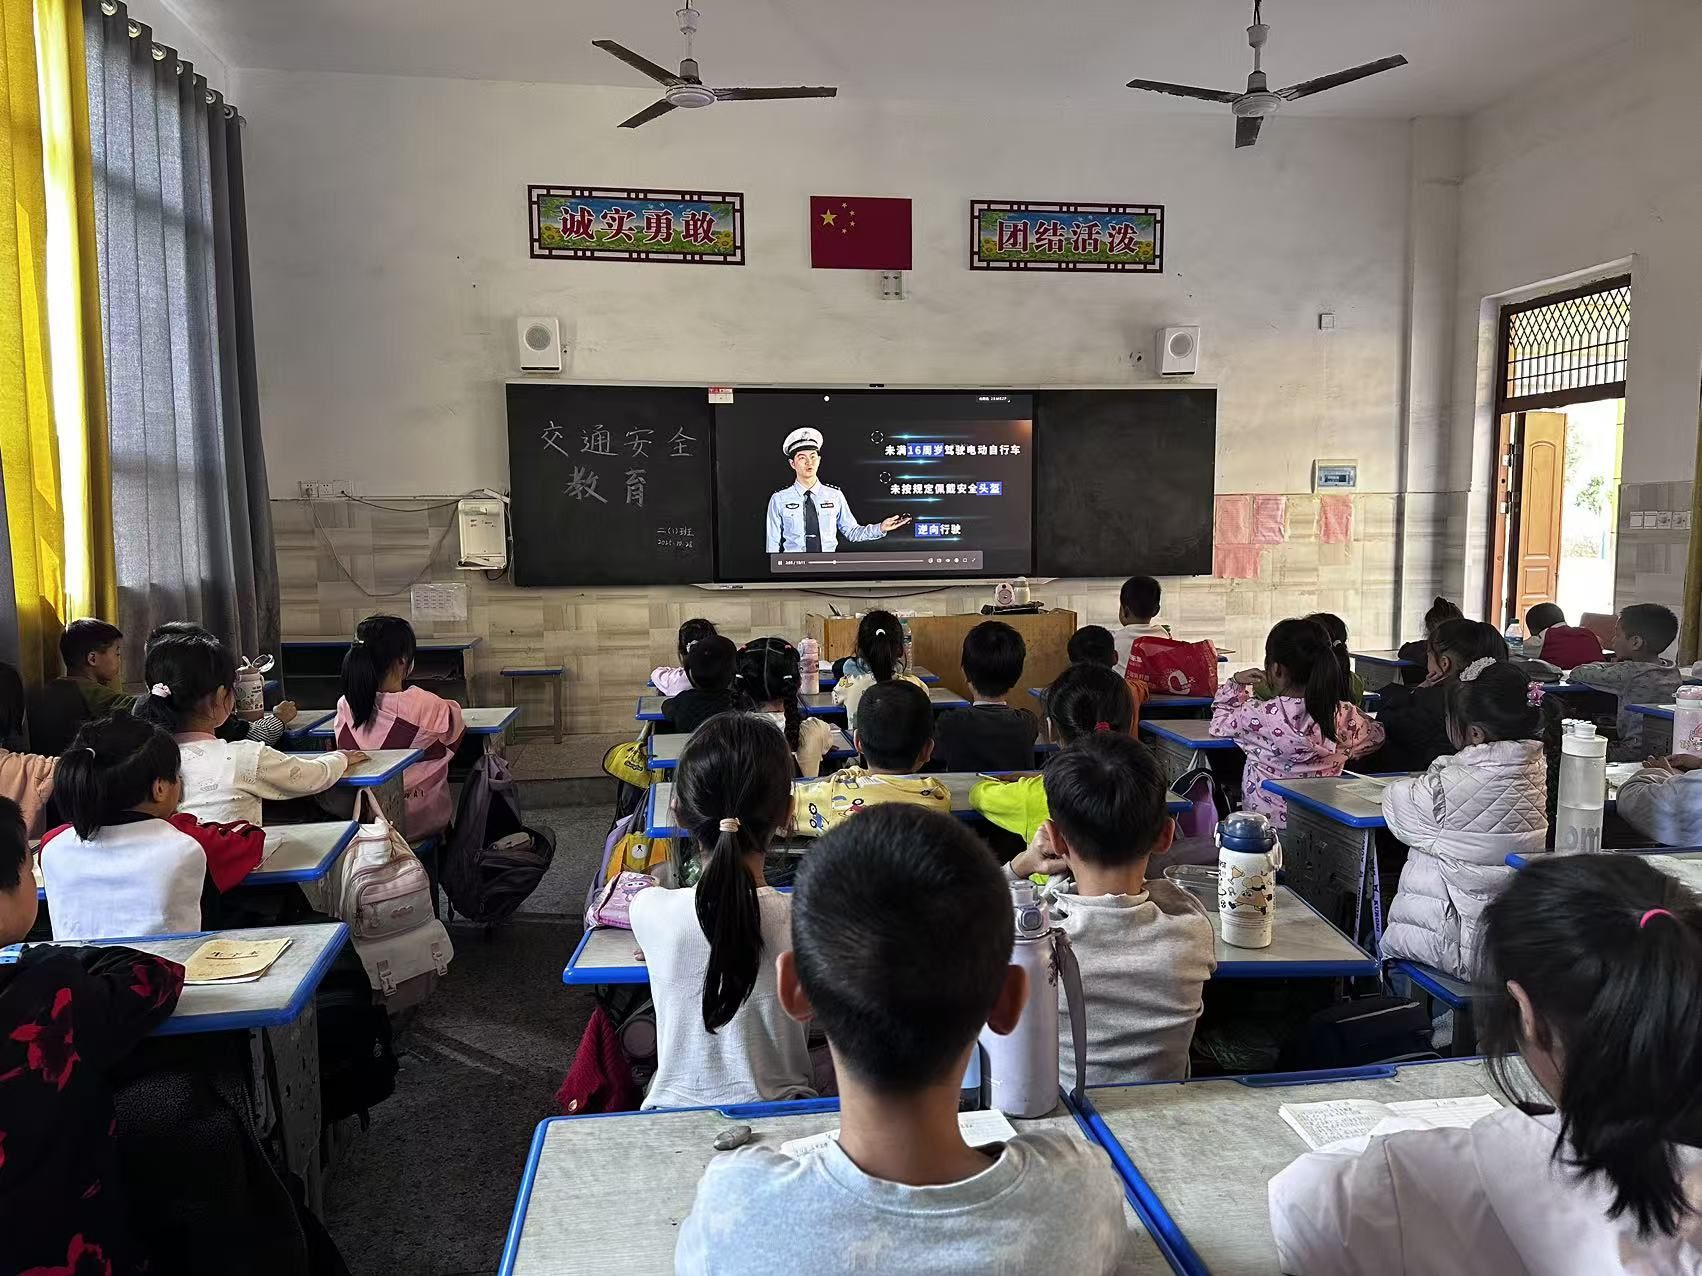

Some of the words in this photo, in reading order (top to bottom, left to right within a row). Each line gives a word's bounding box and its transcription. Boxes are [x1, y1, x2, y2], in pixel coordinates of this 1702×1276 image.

[558, 206, 718, 246] 诚实勇敢
[996, 218, 1139, 256] 团结活泼
[540, 420, 697, 458] 交通安全
[884, 444, 1021, 456] 未满16周岁驾驶电动自行车
[563, 465, 647, 508] 教育
[890, 483, 1001, 495] 未按规定佩戴安全头盔
[918, 524, 961, 535] 逆向行驶
